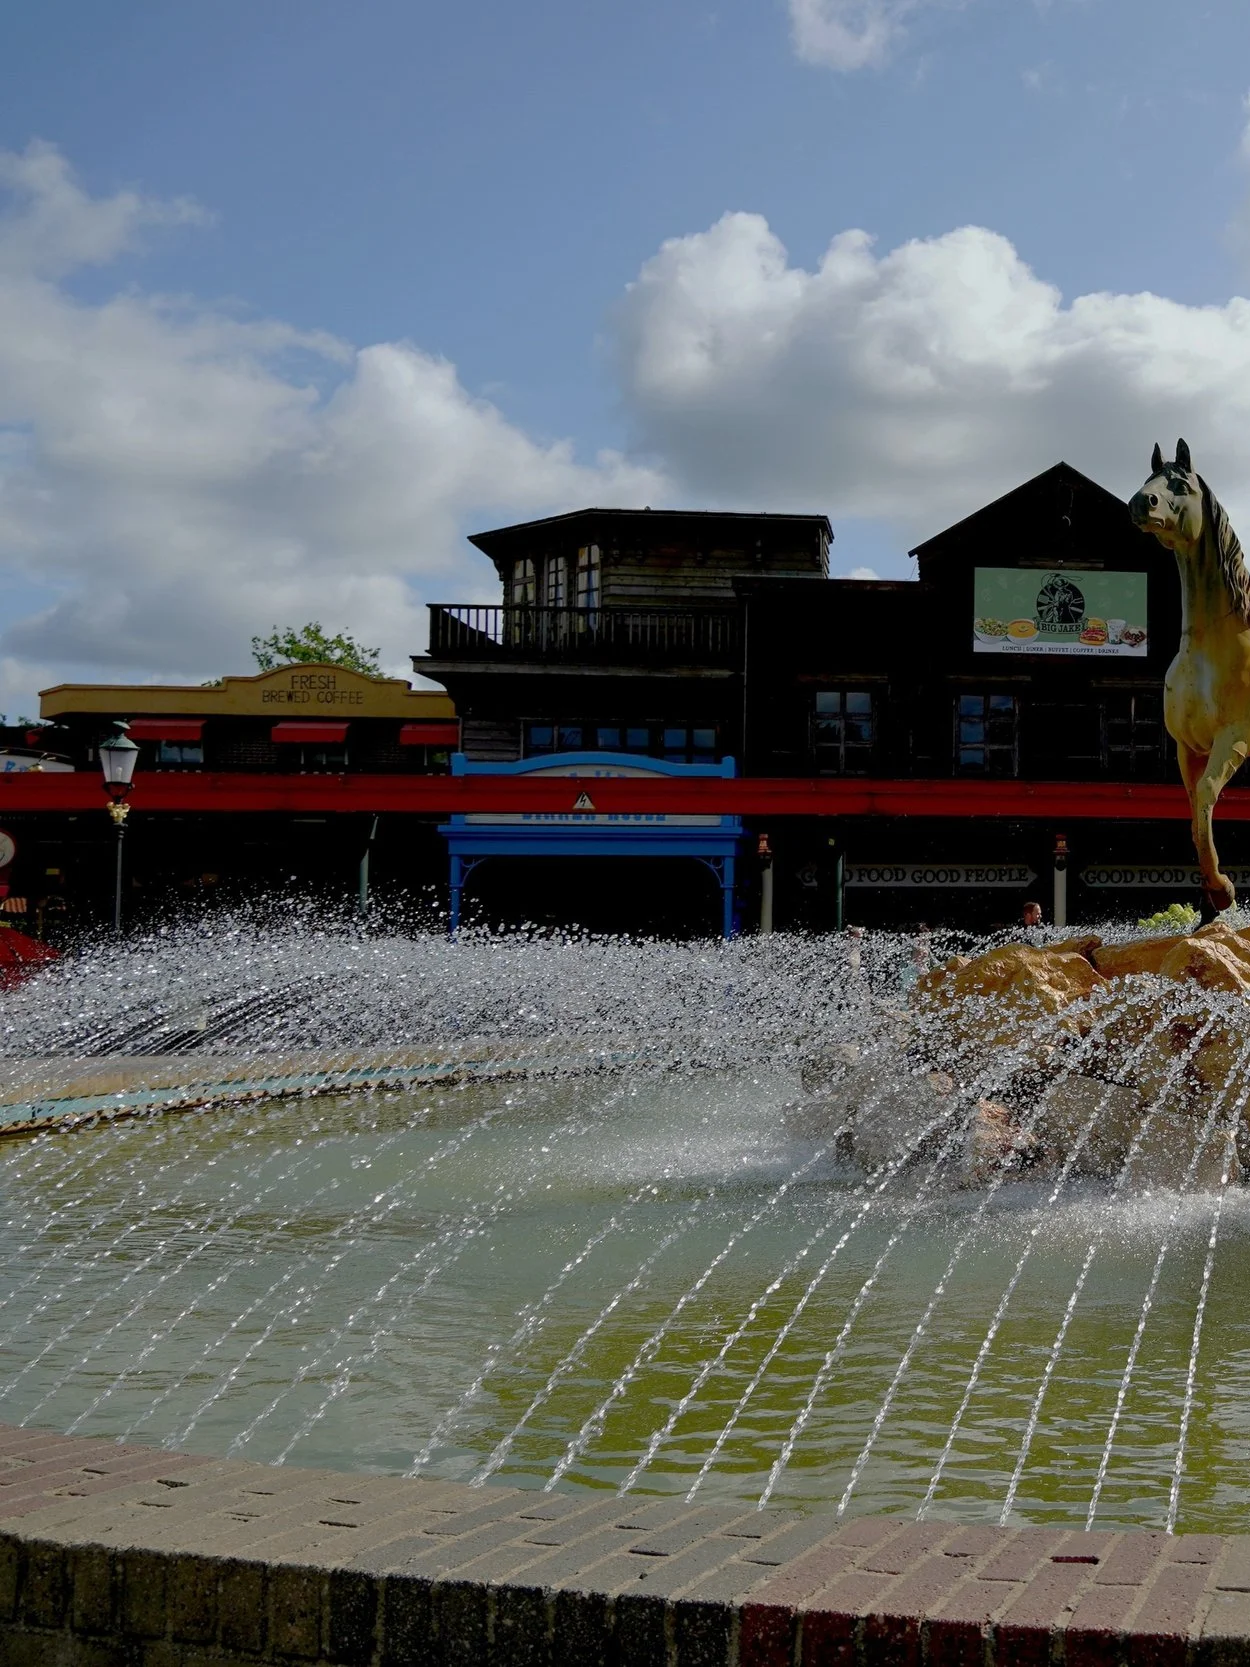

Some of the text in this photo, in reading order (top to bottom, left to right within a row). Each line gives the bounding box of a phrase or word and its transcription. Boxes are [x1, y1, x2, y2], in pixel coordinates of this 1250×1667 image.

[1041, 623, 1081, 633] BIG JAKE
[291, 675, 337, 690] FRESH
[262, 690, 364, 704] BREWED COFFEE
[857, 868, 907, 883] FOOD
[911, 868, 961, 883] GOOD
[965, 868, 1029, 883] PEOPLE
[1084, 869, 1135, 885] GOOD
[1138, 869, 1186, 884] FOOD
